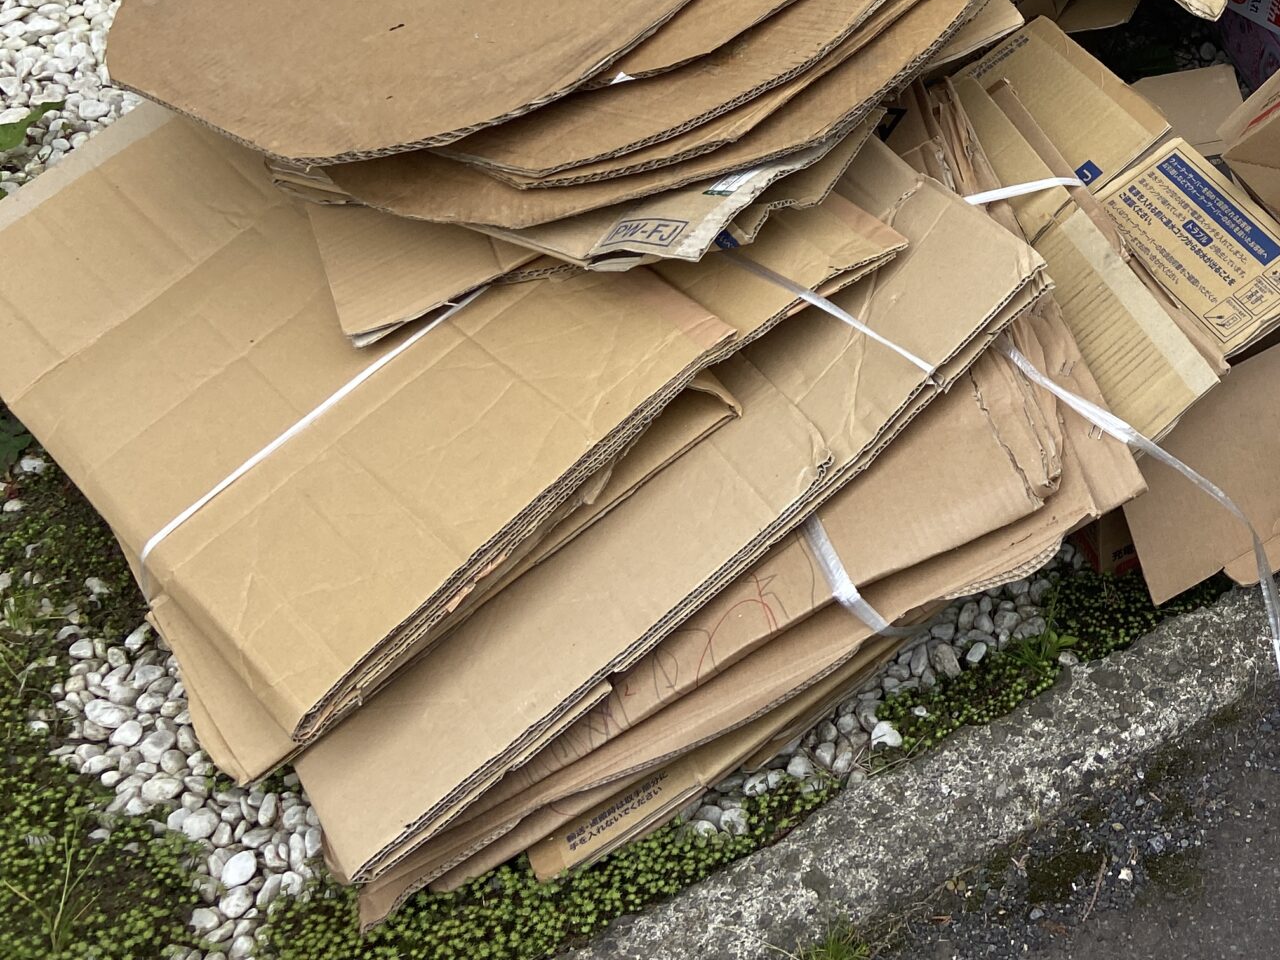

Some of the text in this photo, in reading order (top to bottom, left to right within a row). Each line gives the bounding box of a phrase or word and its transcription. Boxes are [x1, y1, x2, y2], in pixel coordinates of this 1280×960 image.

[611, 222, 680, 242] PW-FJ
[1185, 221, 1209, 244] トラブル
